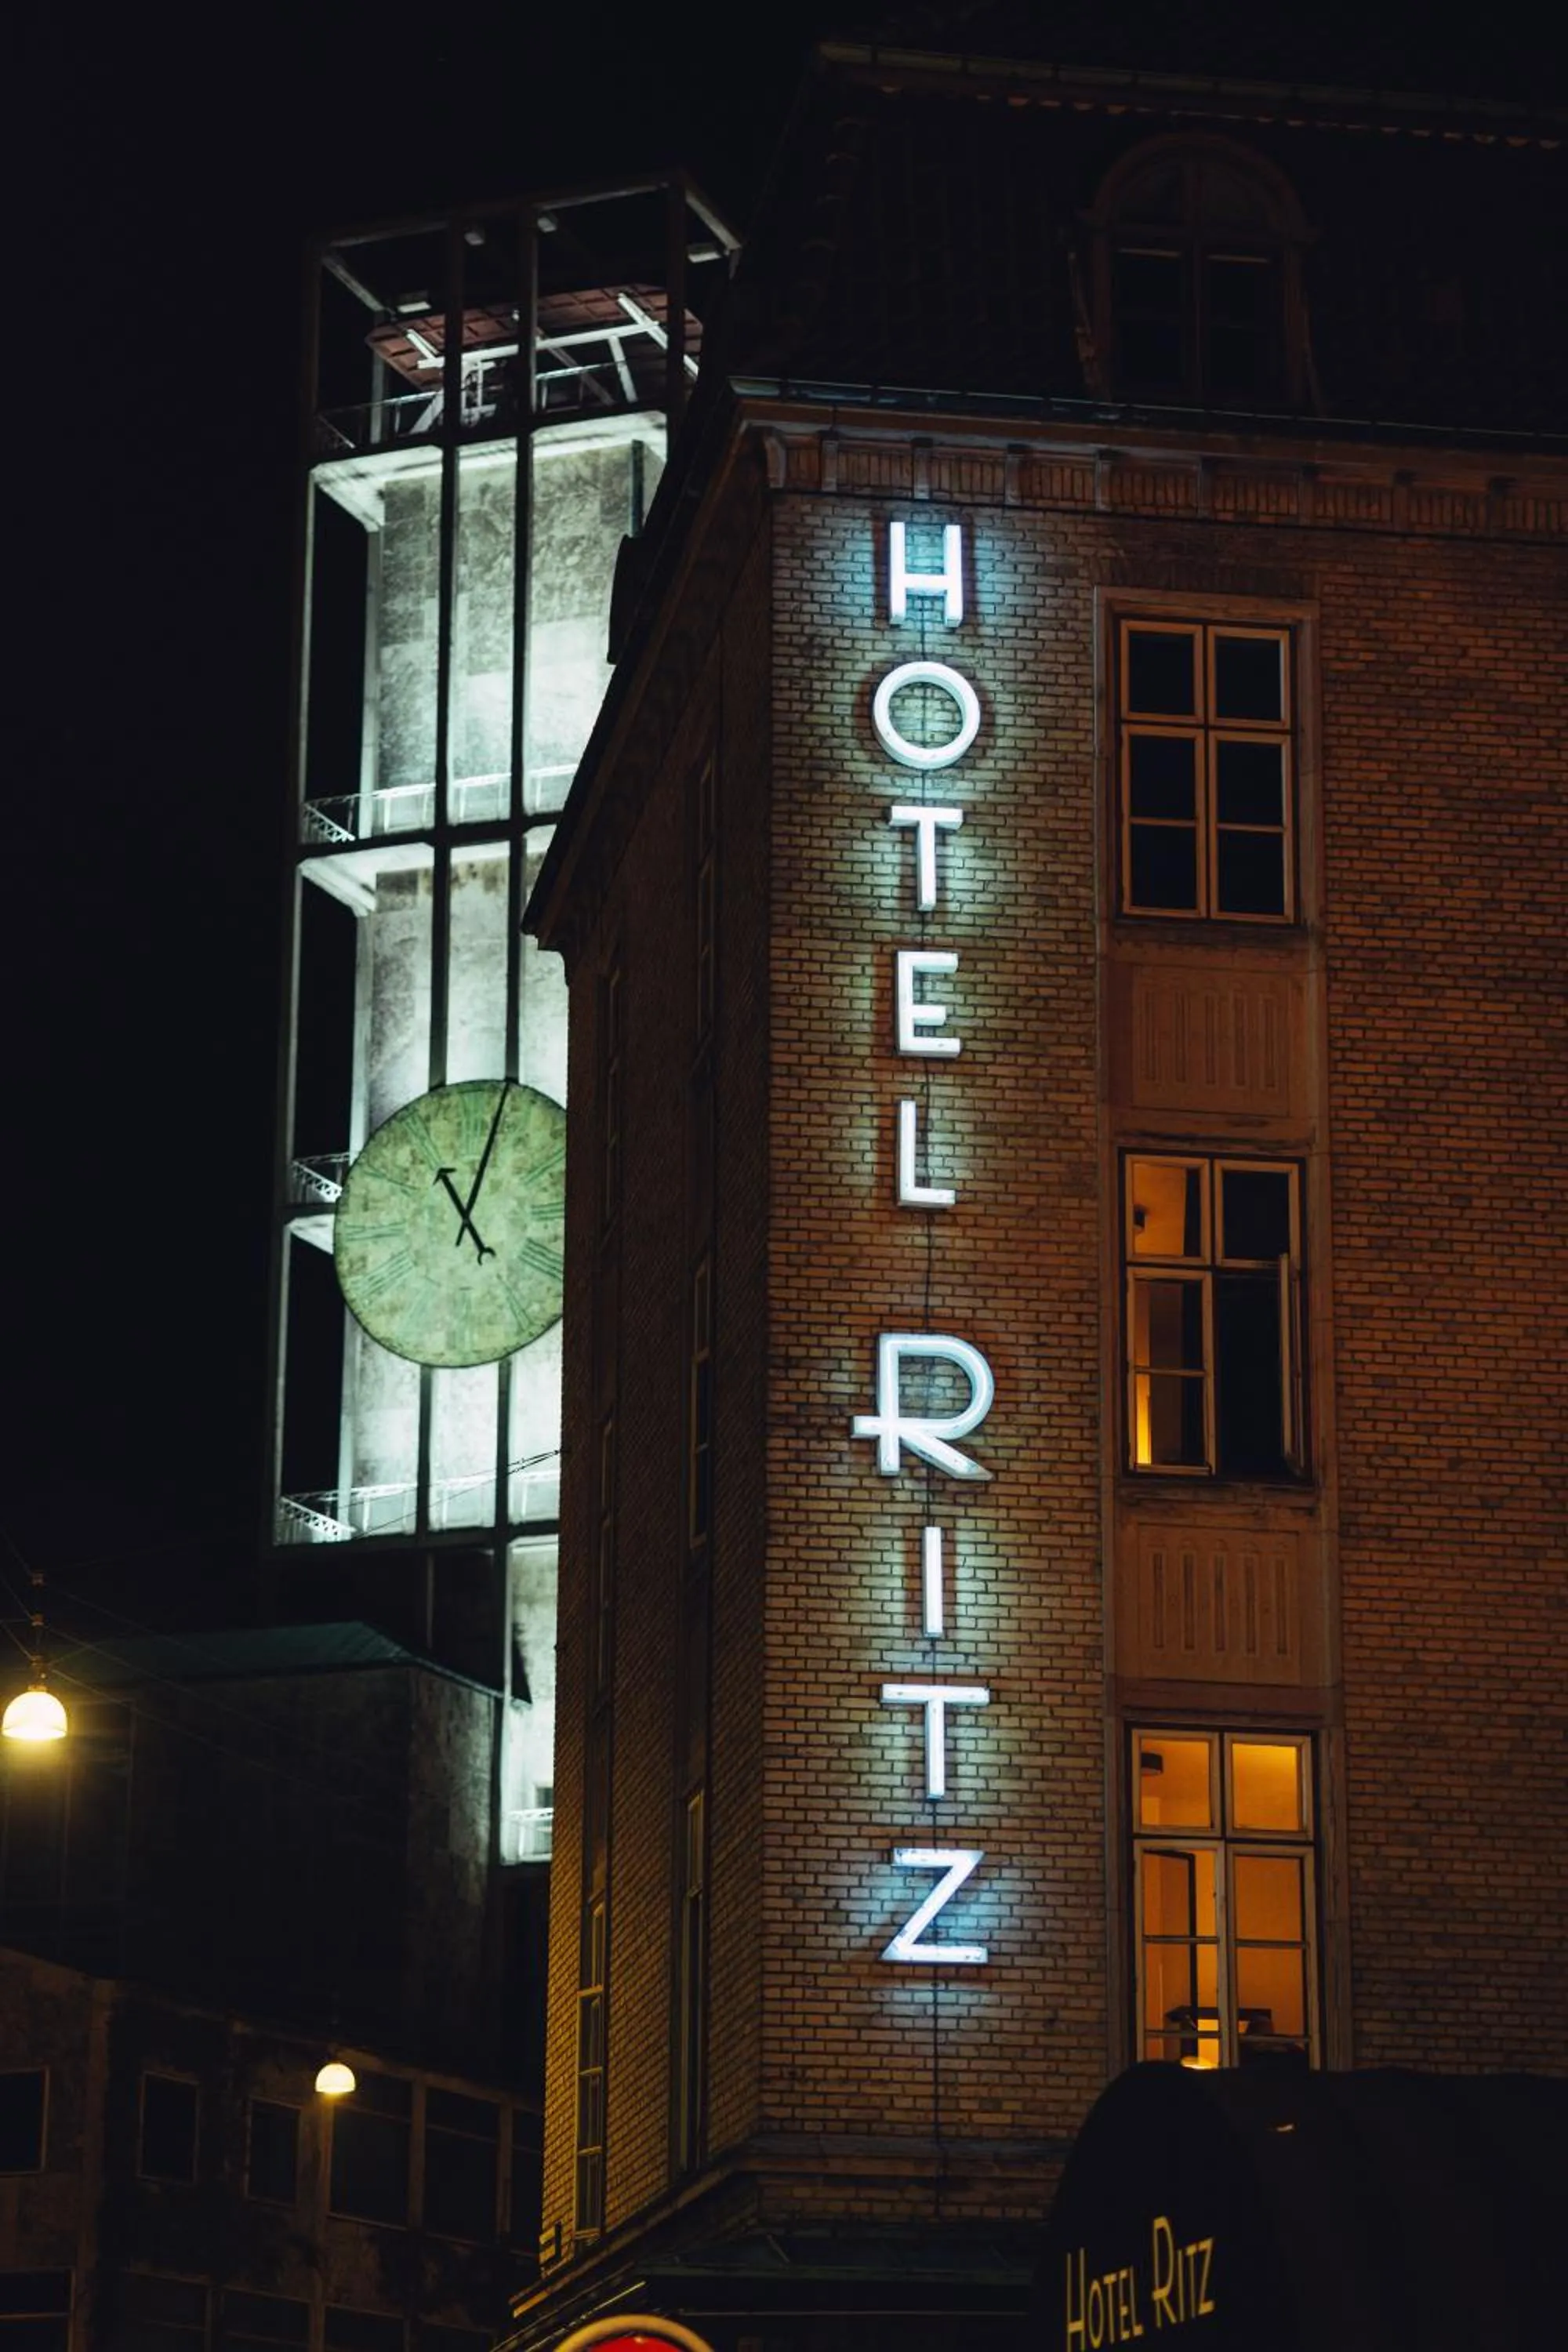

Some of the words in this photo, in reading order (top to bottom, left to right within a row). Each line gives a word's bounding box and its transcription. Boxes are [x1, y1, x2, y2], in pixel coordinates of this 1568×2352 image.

[873, 521, 982, 1209] HOTEL
[852, 1332, 994, 1963] RITZ
[1065, 2246, 1144, 2352] HOTEL
[1152, 2214, 1215, 2330] RITZ
